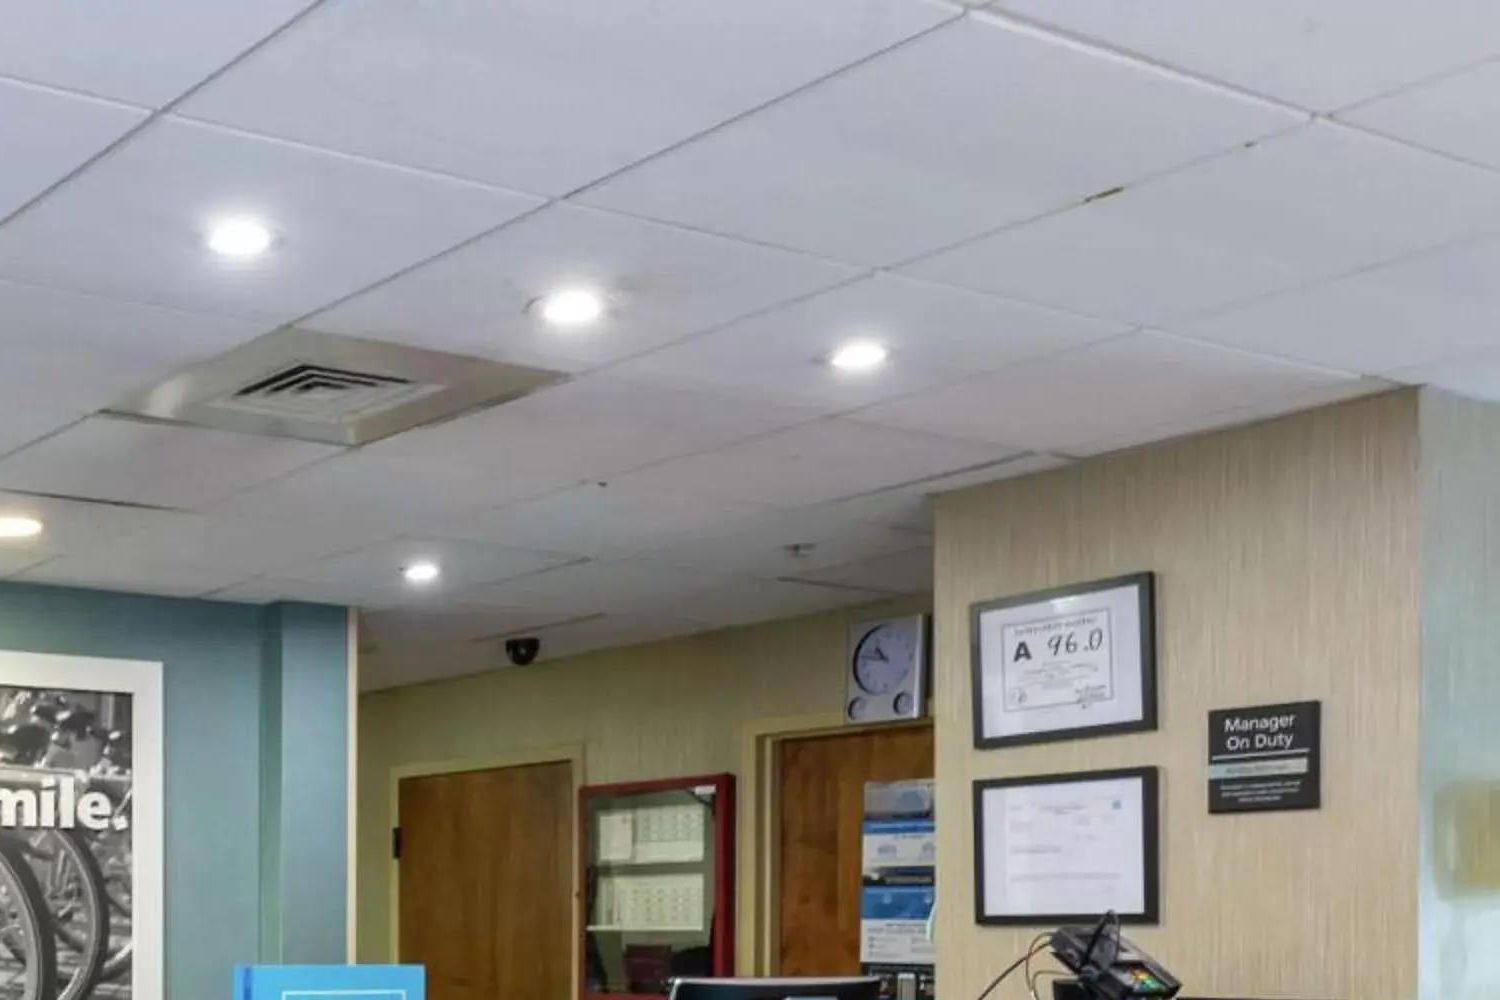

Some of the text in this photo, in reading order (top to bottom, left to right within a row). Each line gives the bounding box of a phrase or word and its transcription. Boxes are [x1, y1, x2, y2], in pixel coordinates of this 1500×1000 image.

[1013, 640, 1032, 662] A
[1224, 714, 1297, 733] Manager
[1226, 733, 1294, 751] On Duty
